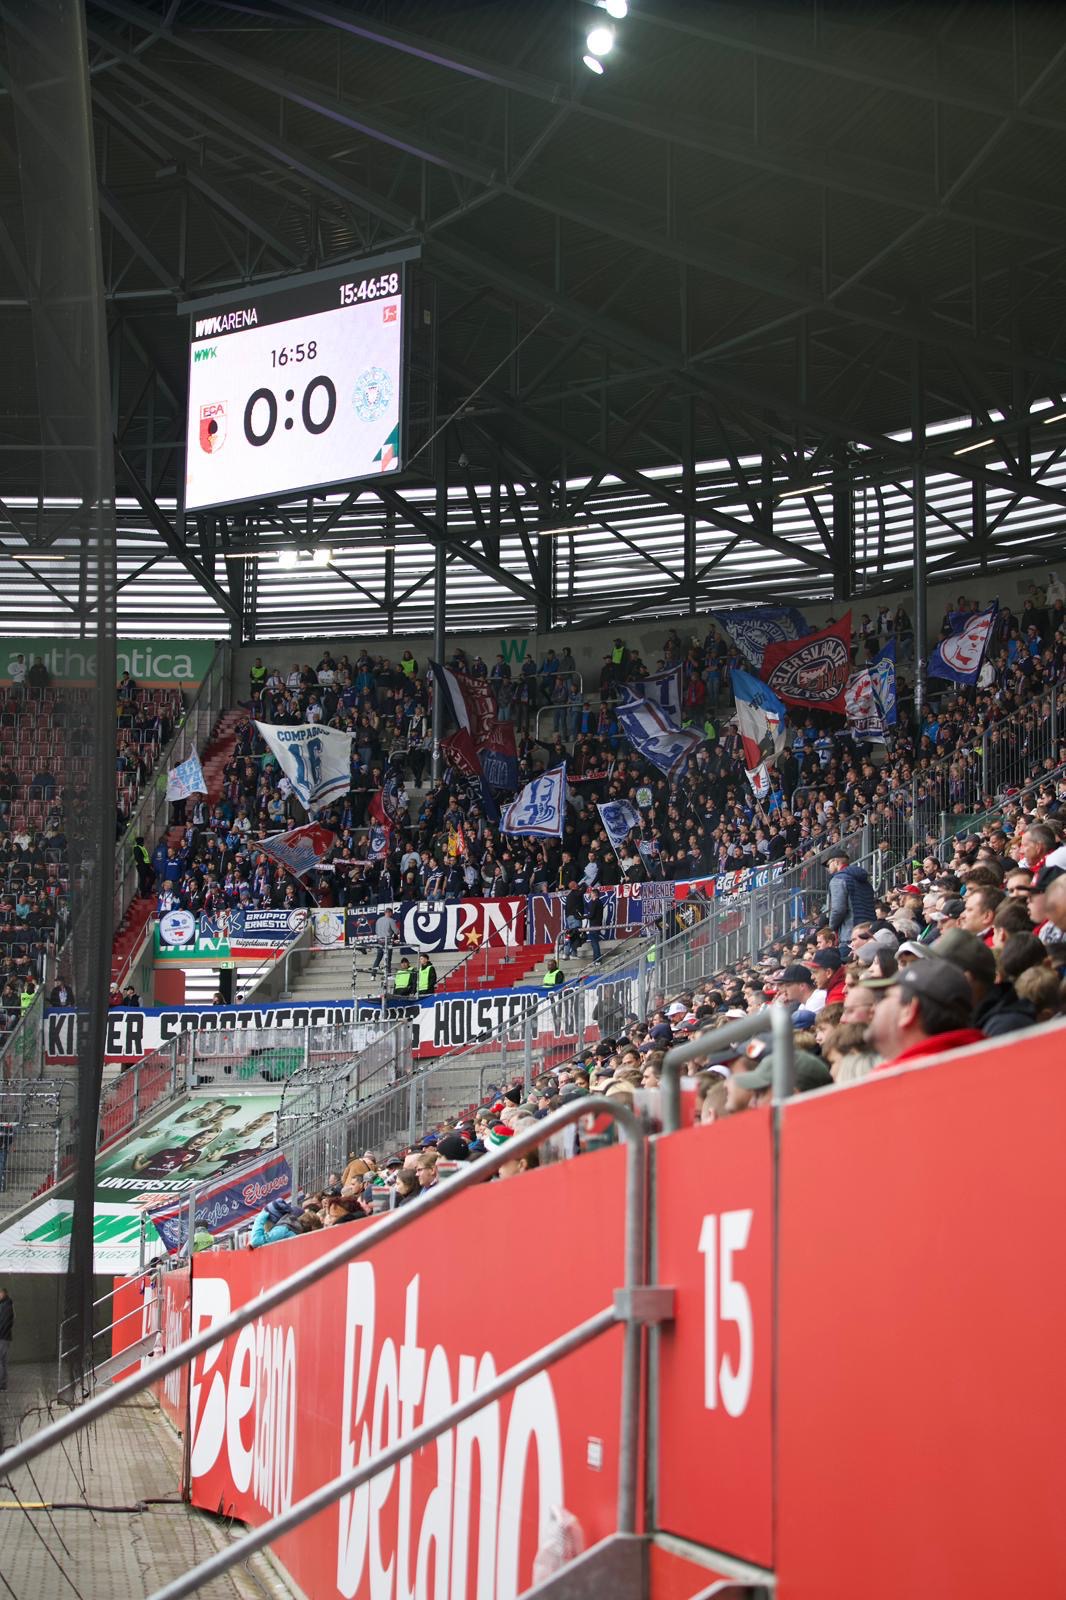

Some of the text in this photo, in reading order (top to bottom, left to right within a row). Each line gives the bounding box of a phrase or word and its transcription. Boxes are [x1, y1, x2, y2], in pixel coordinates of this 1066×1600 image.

[339, 273, 399, 305] 15:46:58
[194, 346, 218, 362] WWK
[271, 340, 318, 368] 16:58
[243, 374, 337, 447] 0:0
[244, 920, 287, 929] ERNESTO
[246, 912, 287, 921] GRUPPO
[194, 1173, 289, 1226] Kyle's Eleven
[697, 1208, 754, 1417] 15
[191, 1277, 297, 1518] Betano
[337, 1261, 565, 1600] Betano
